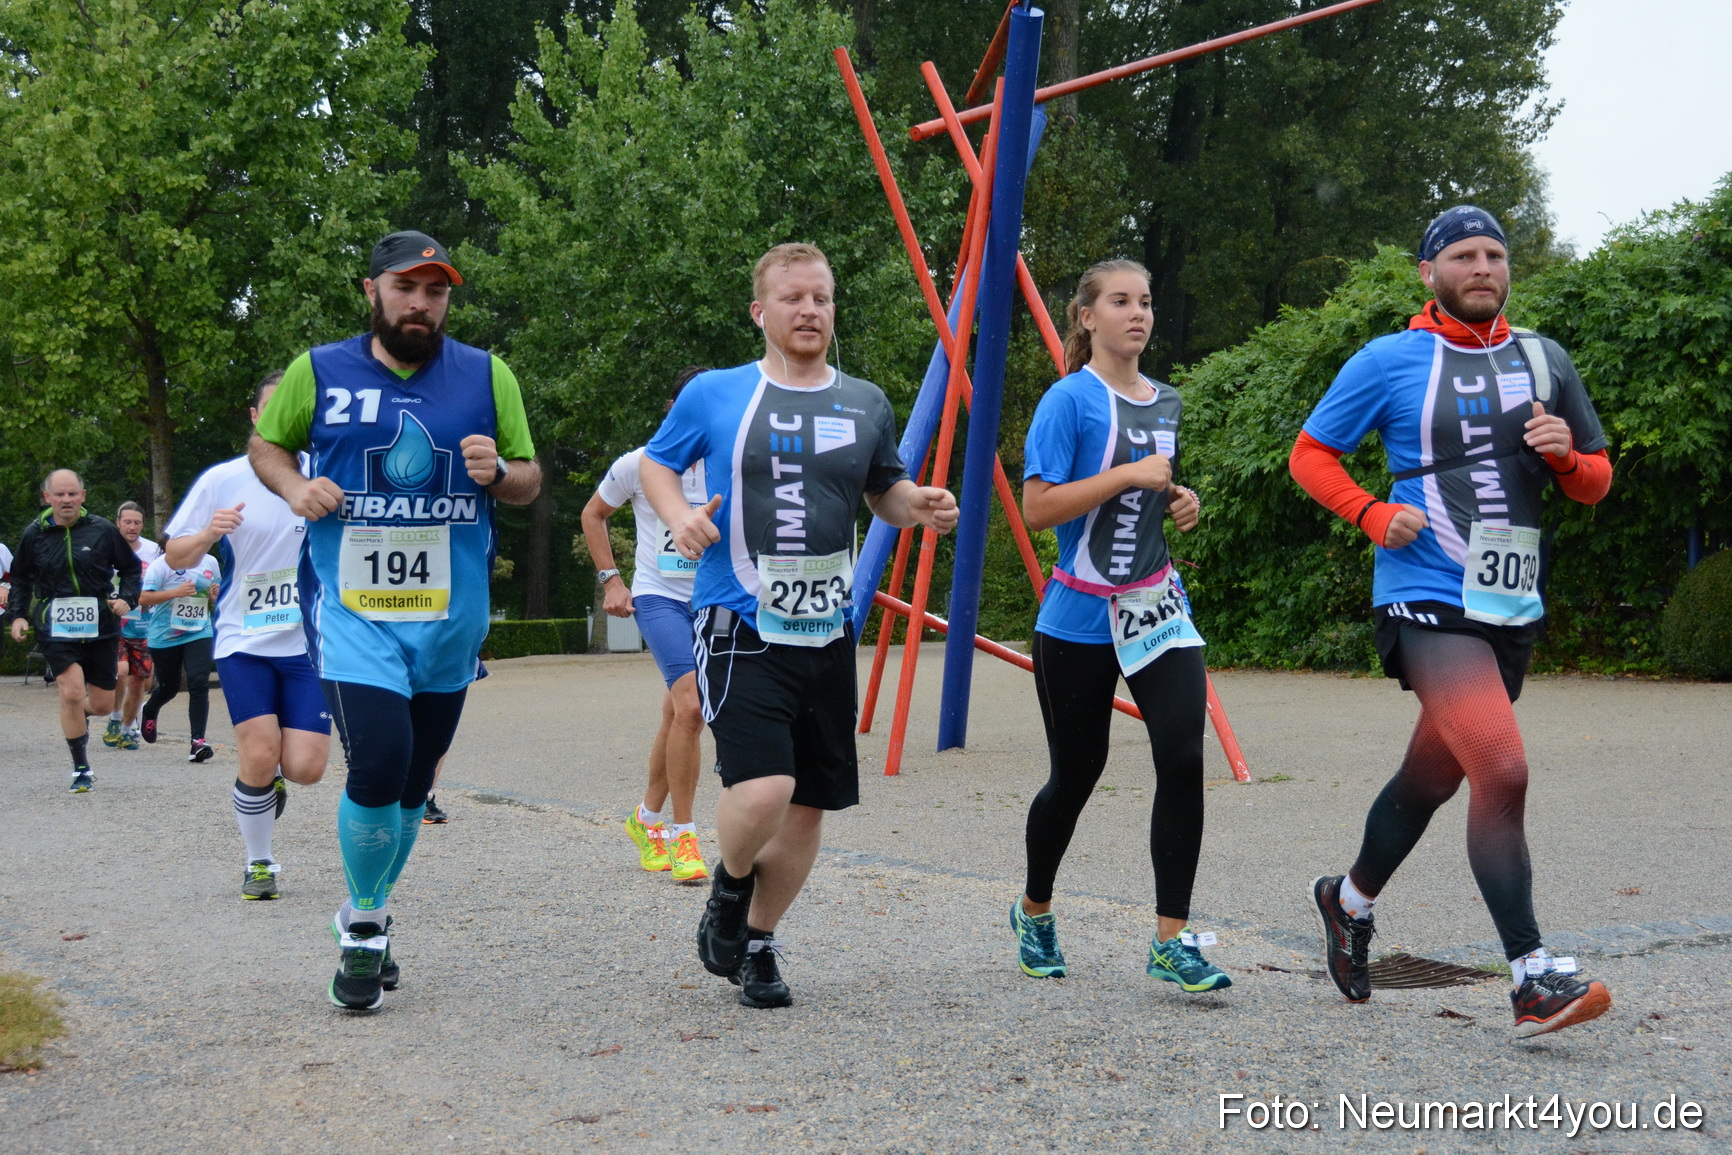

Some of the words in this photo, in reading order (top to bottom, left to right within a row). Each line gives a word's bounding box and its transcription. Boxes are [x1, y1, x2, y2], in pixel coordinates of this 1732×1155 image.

[325, 387, 382, 425] 21
[340, 496, 476, 520] FIBALON
[1109, 428, 1150, 576] HIMAEC
[390, 530, 441, 541] BOCK
[1480, 535, 1512, 544] NeuerMarkt
[364, 551, 430, 585] 194
[677, 559, 699, 569] Conn
[1477, 550, 1536, 592] 3039
[359, 594, 432, 608] Constantin
[771, 576, 846, 615] 2253
[57, 607, 94, 622] 2358
[176, 604, 204, 618] 2334
[265, 613, 290, 624] Peter
